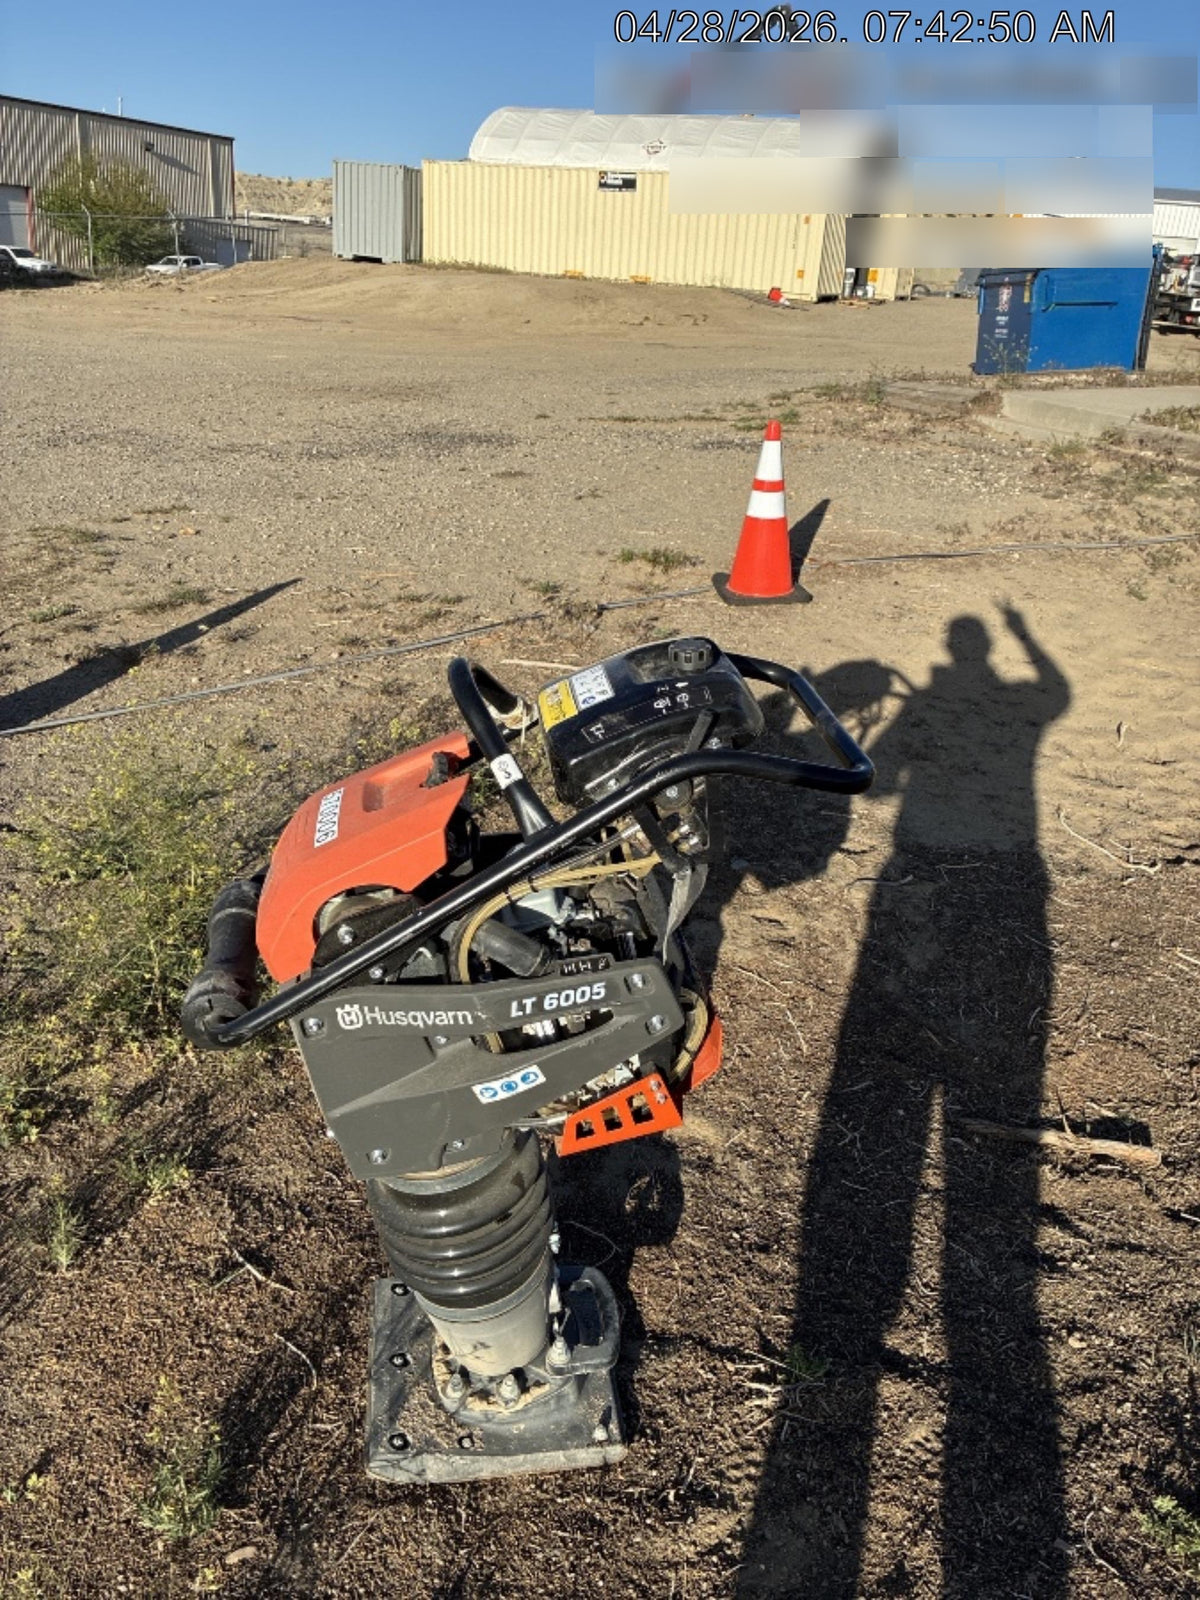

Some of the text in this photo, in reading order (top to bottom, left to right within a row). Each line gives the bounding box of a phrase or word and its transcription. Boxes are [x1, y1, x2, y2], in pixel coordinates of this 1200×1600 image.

[510, 982, 606, 1018] LT 6005
[364, 1006, 486, 1035] Husqvarn
